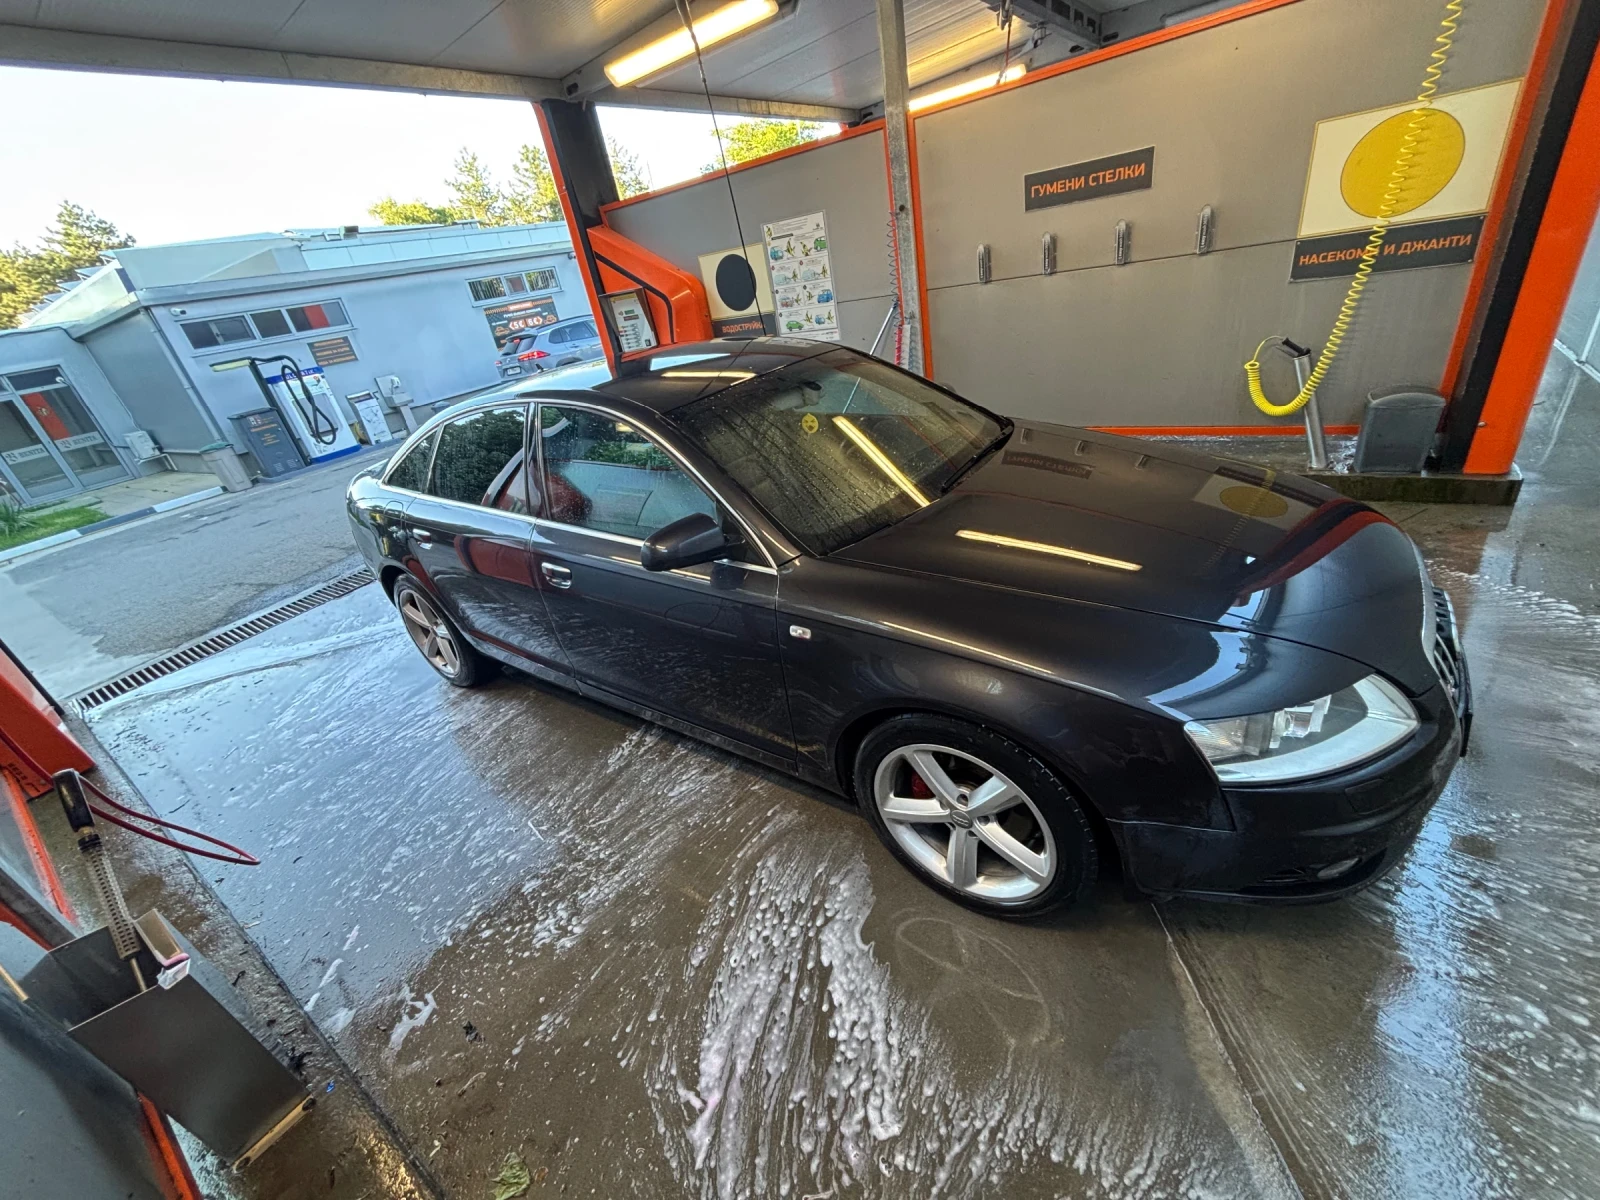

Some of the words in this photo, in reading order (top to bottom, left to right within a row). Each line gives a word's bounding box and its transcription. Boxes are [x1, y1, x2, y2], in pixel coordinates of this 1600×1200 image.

[1031, 176, 1084, 198] ГУМЕНИ
[1088, 163, 1146, 186] СТЕЛКИ
[1383, 243, 1396, 256] И
[1397, 234, 1473, 256] ДЖАНТИ
